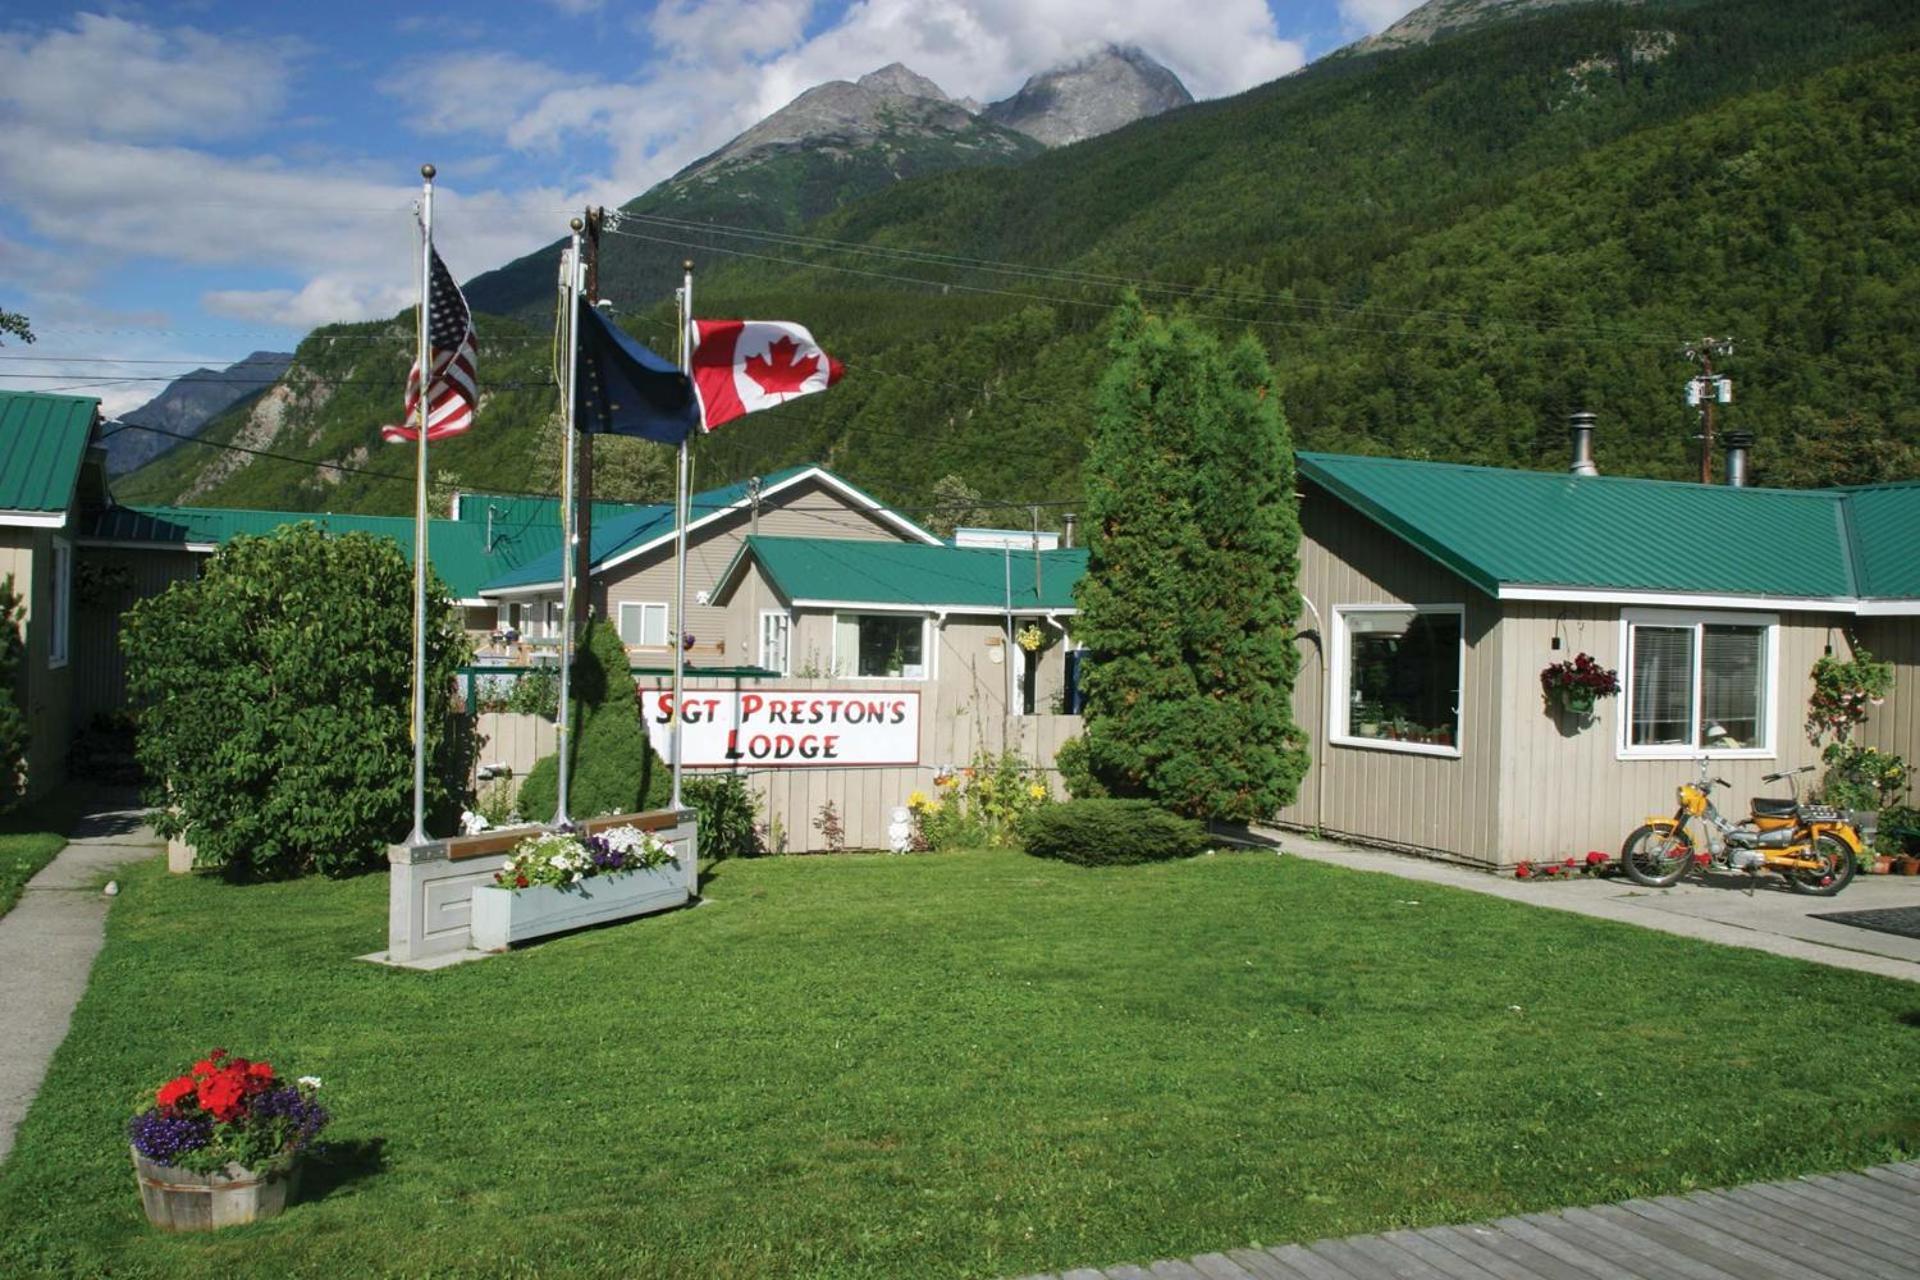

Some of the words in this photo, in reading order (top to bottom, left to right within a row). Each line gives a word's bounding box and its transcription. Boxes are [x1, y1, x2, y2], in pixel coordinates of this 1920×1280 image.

[656, 694, 720, 724] SGT
[741, 694, 906, 725] PRESTON'S
[725, 729, 840, 759] LODGE
